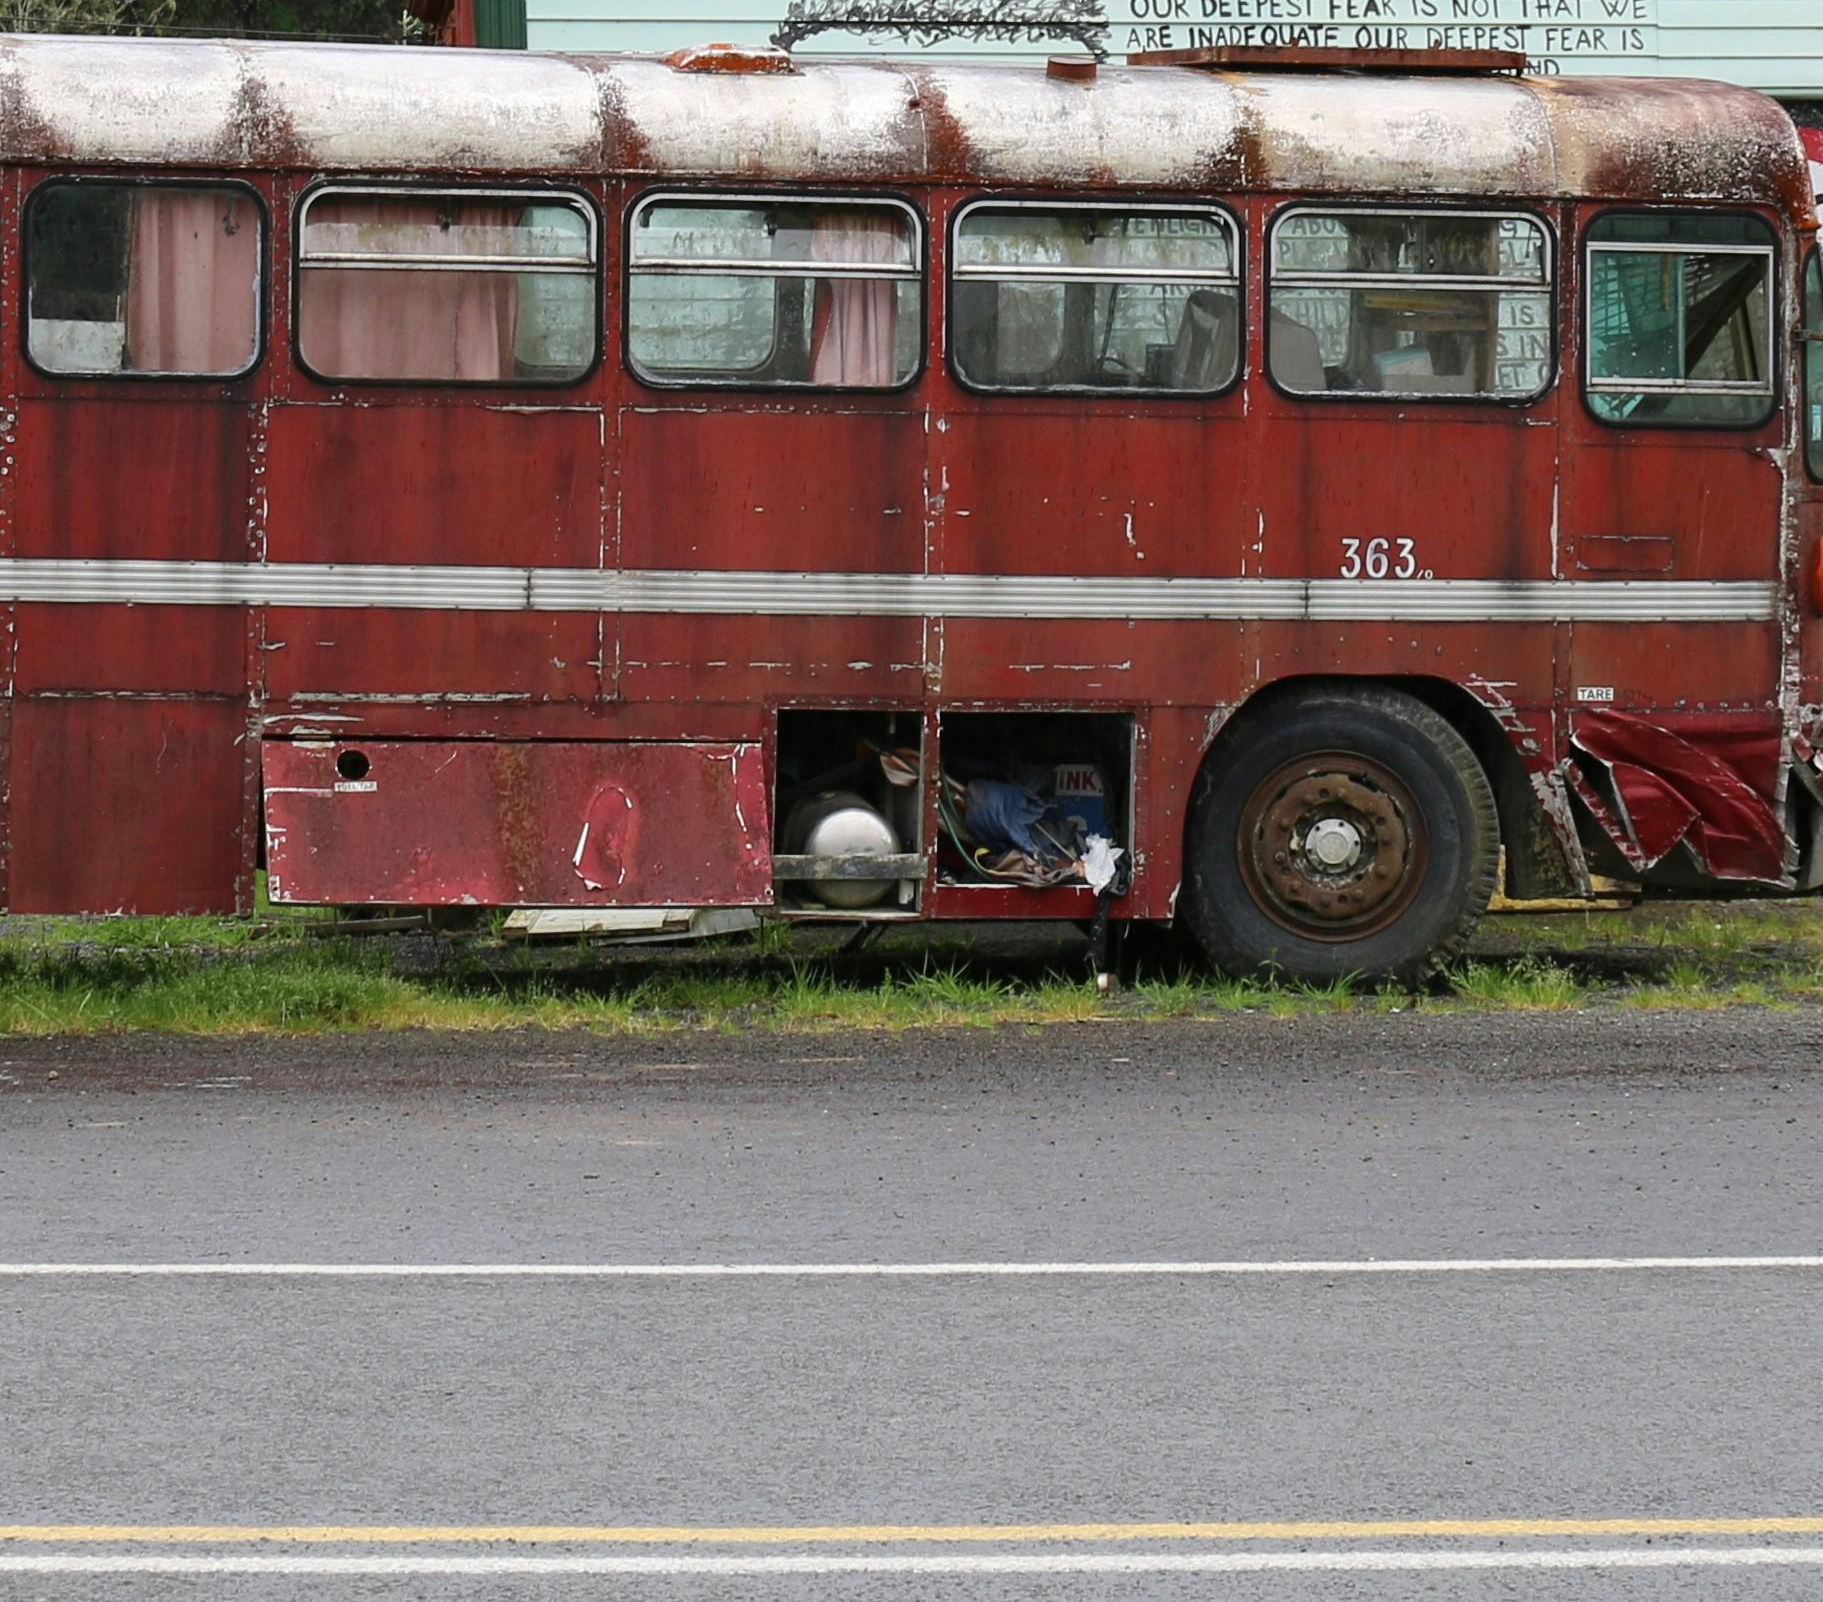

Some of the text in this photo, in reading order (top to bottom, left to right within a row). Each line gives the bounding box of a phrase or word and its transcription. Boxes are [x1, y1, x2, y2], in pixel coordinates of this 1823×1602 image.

[1127, 26, 1173, 48] ARE
[1355, 26, 1408, 49] OUR
[1427, 25, 1532, 50] DEEPEST
[1545, 28, 1608, 51] FEAR
[1622, 28, 1645, 50] IS
[1578, 689, 1612, 700] TARE
